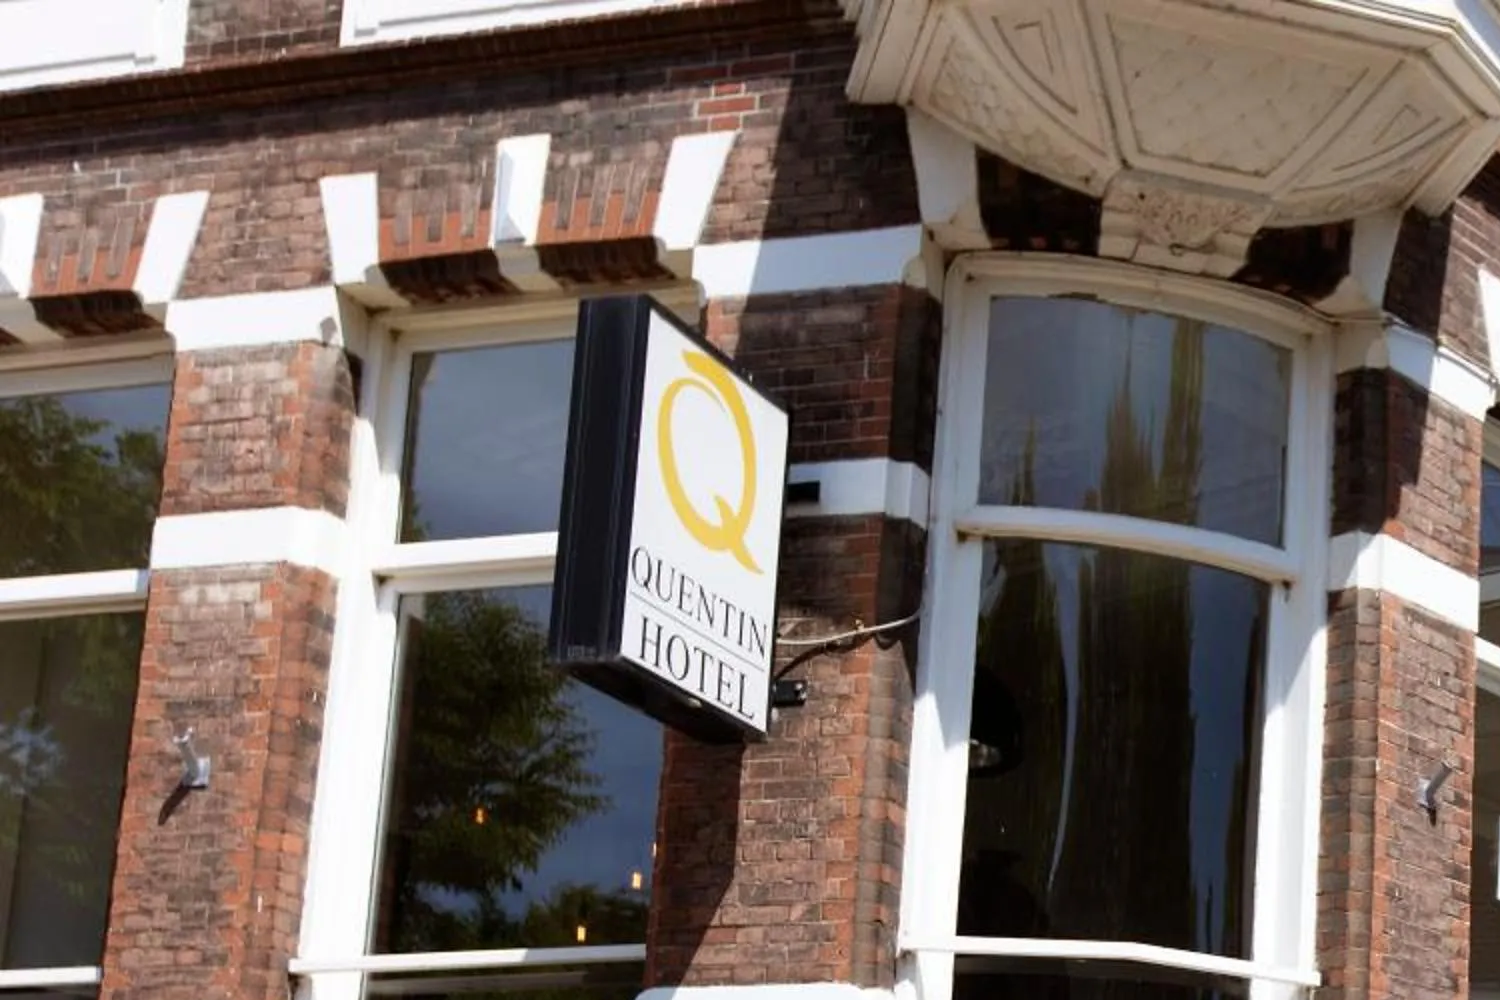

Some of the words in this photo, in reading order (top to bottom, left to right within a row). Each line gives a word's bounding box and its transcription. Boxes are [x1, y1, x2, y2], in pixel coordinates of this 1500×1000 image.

[656, 349, 765, 575] Q
[631, 545, 768, 660] QUENTIN
[639, 615, 755, 720] HOTEL
